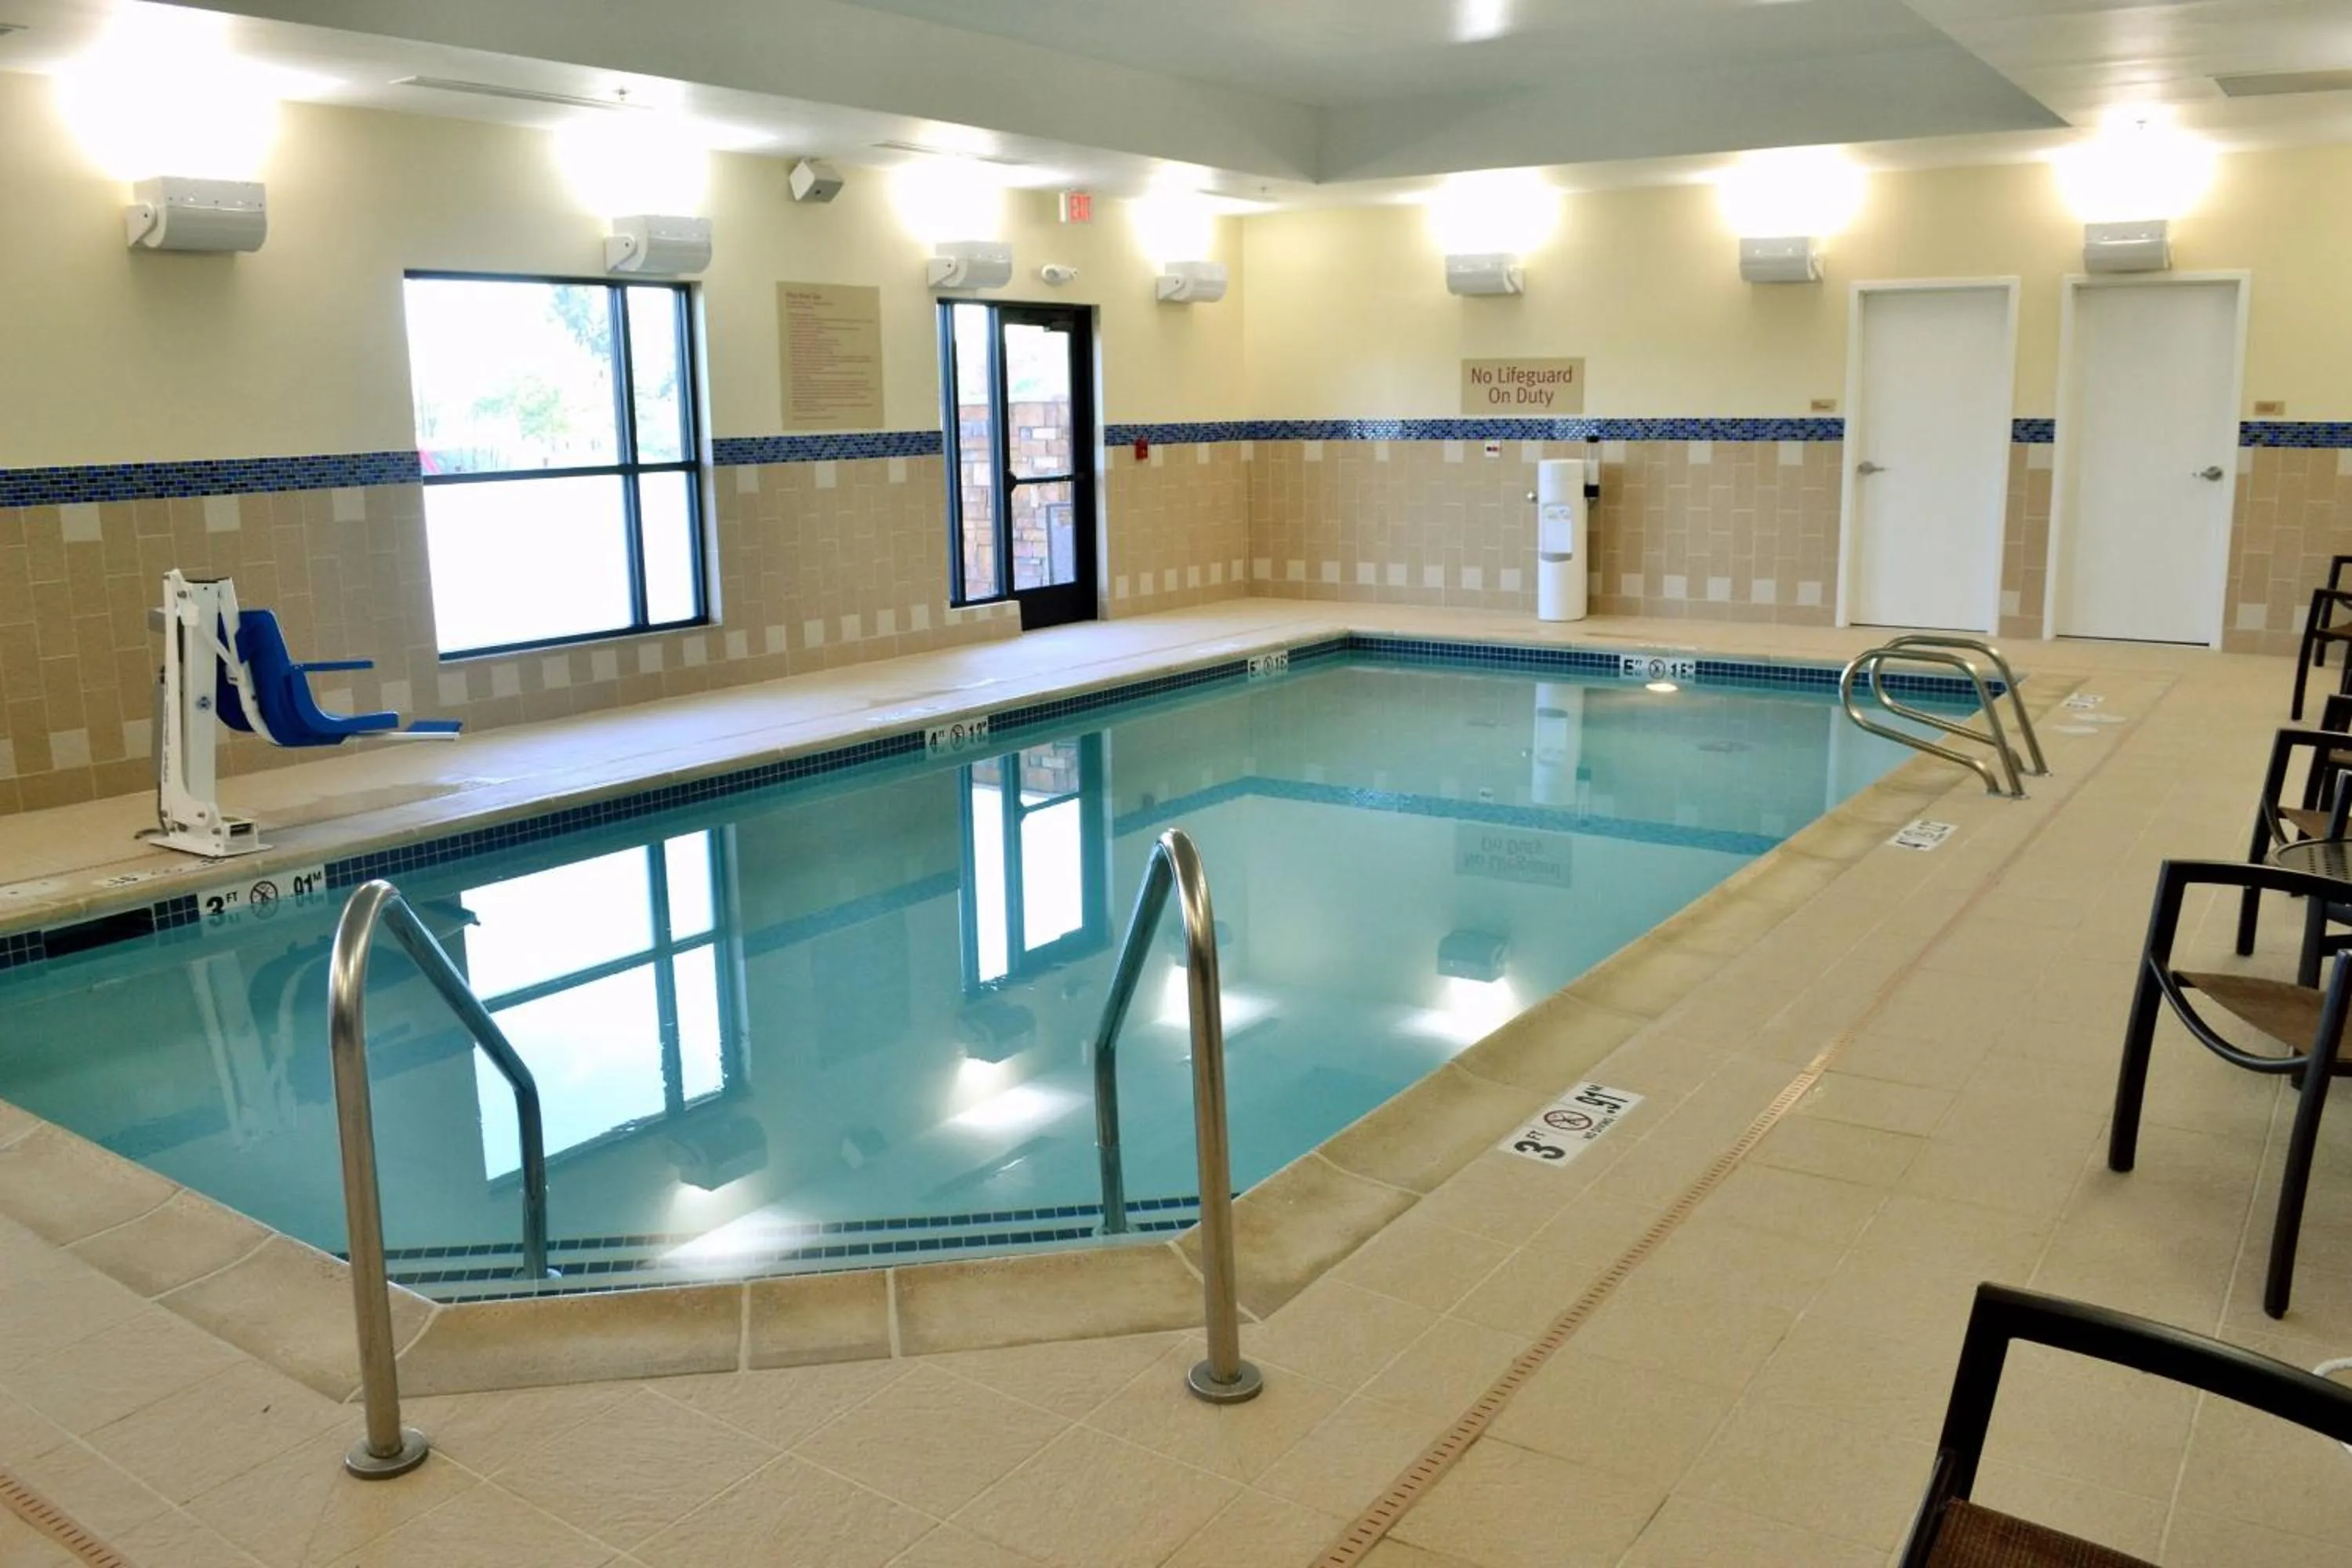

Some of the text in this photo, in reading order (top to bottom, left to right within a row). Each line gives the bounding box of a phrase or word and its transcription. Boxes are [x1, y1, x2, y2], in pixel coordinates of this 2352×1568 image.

[1471, 366, 1573, 387] No Lifeguard
[1488, 387, 1554, 408] On Duty
